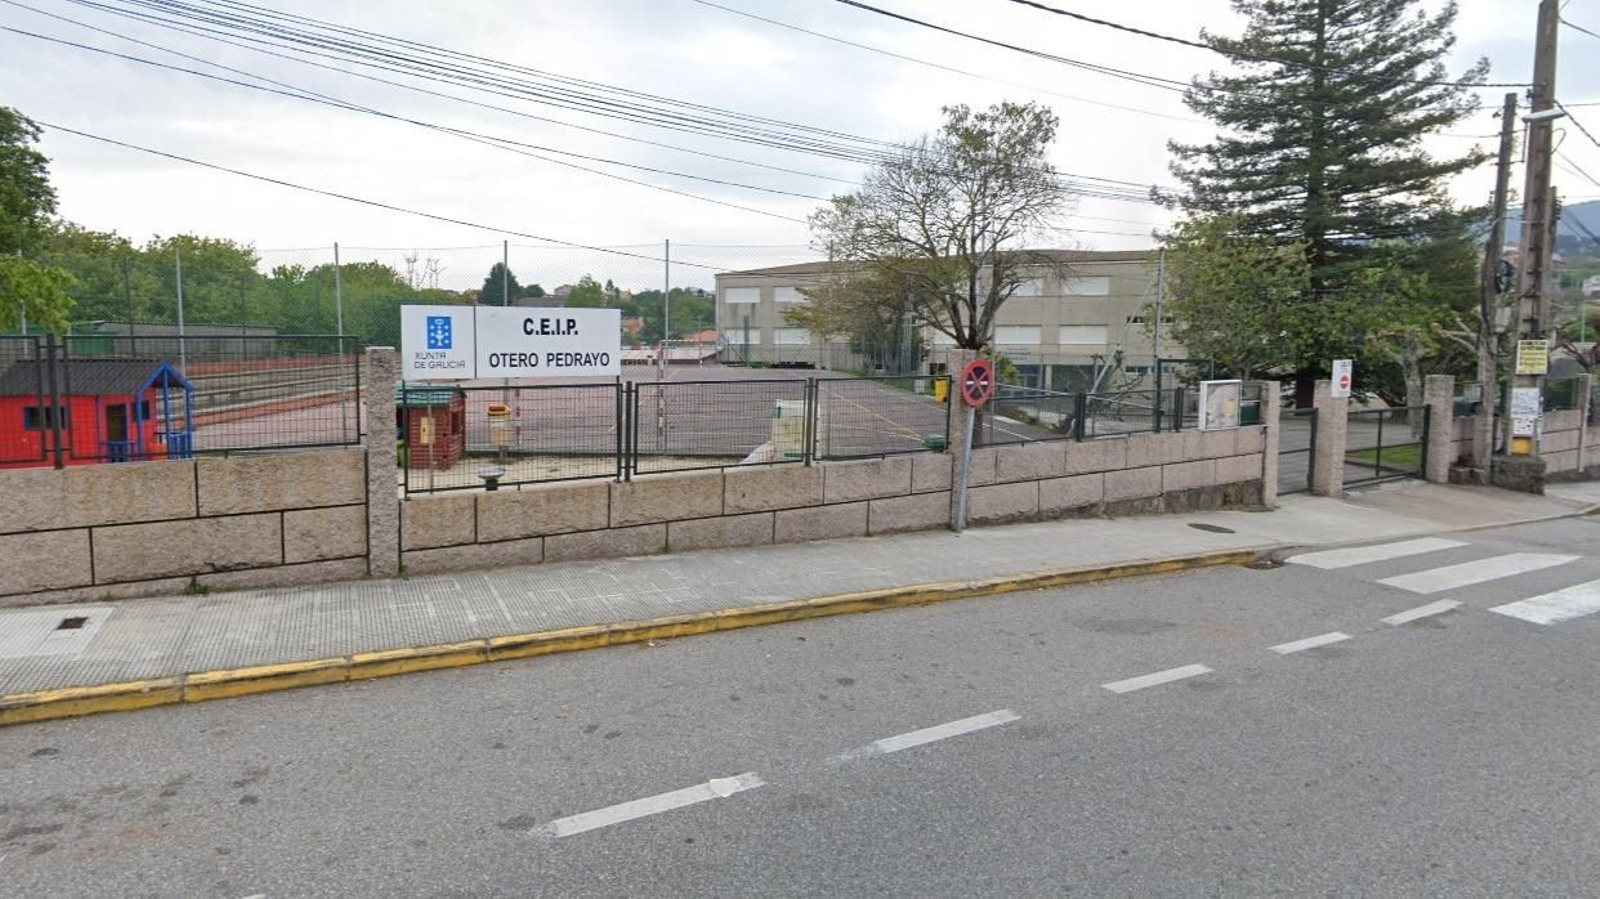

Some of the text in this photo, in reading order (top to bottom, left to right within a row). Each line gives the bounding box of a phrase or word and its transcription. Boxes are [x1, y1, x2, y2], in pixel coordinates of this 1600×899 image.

[523, 318, 579, 336] C.E.I.P.
[415, 351, 447, 360] XUNTA
[489, 352, 610, 368] OTERO PEDRAYO
[414, 360, 466, 369] DE GALICIA
